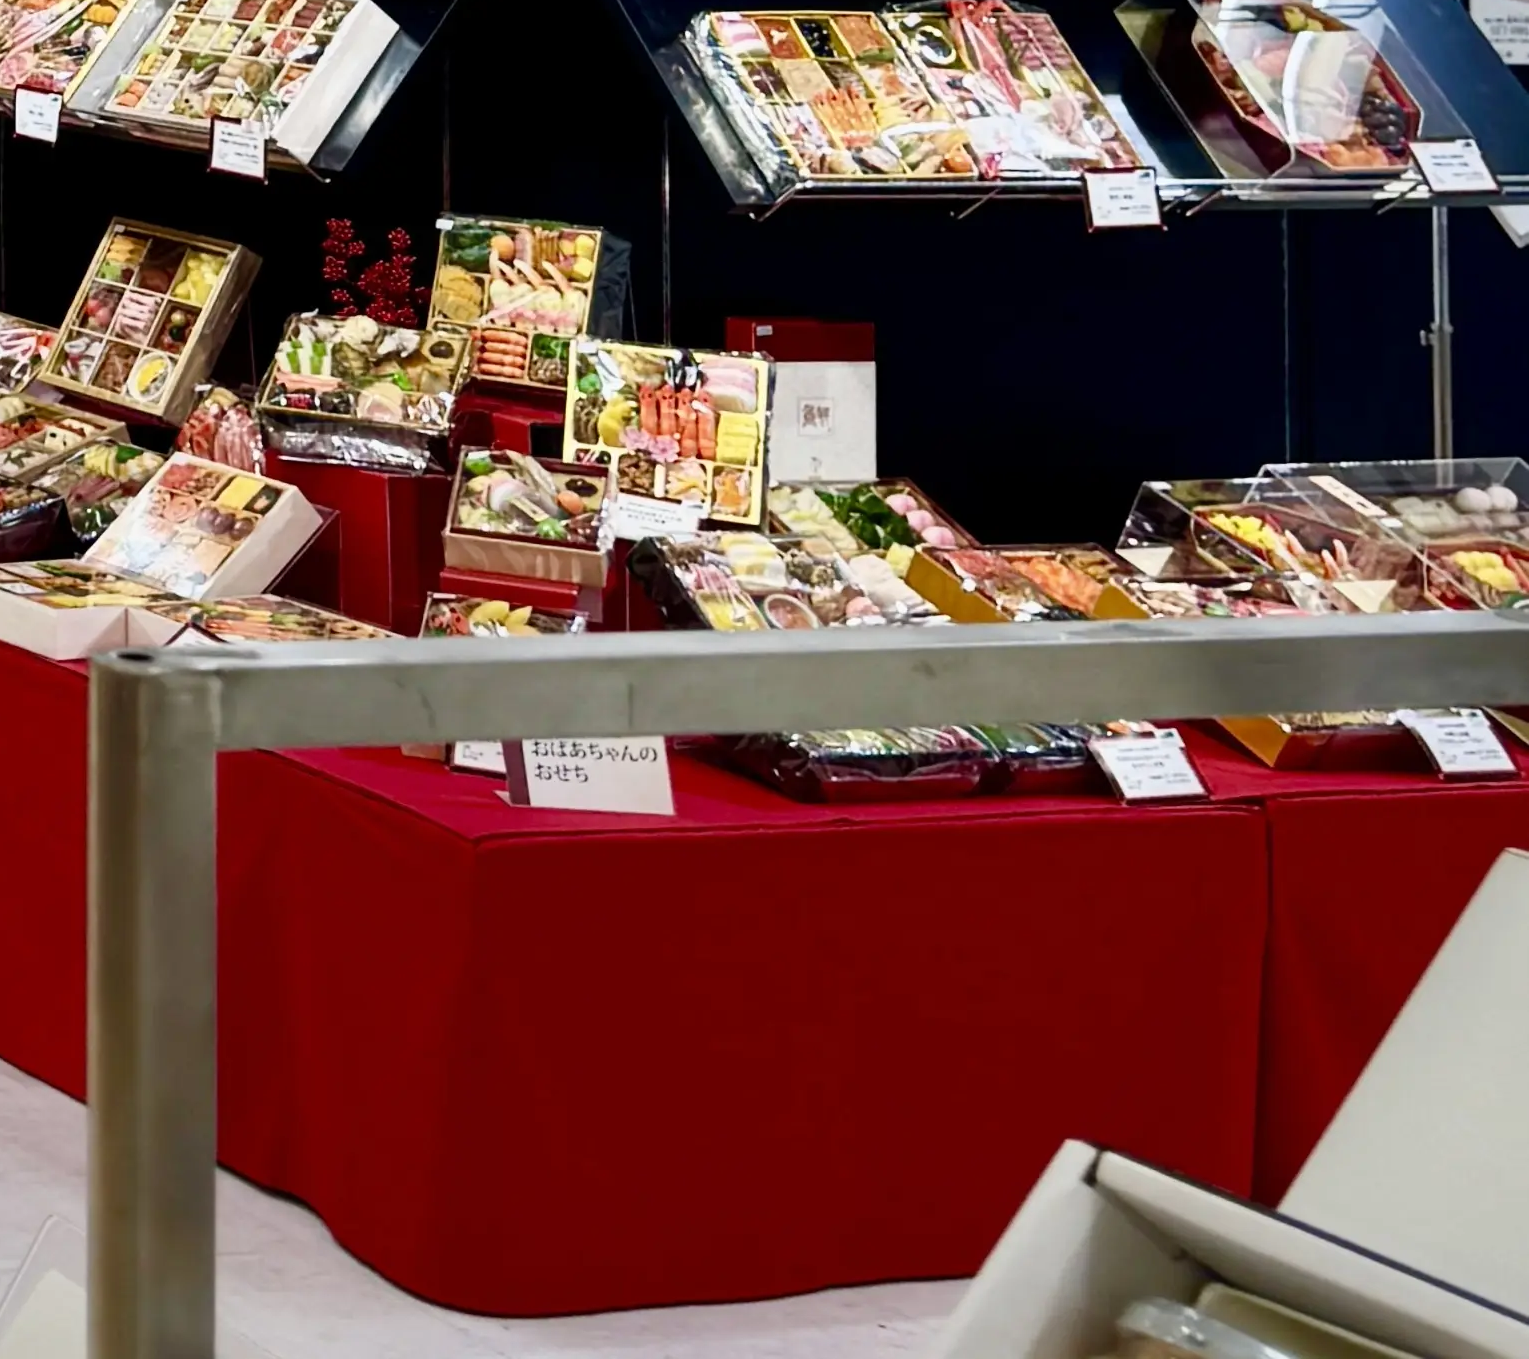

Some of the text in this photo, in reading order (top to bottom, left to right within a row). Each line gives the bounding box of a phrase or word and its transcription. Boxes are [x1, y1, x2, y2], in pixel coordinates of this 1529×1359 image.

[531, 739, 659, 763] おばあちゃんの
[534, 763, 589, 784] おせち
